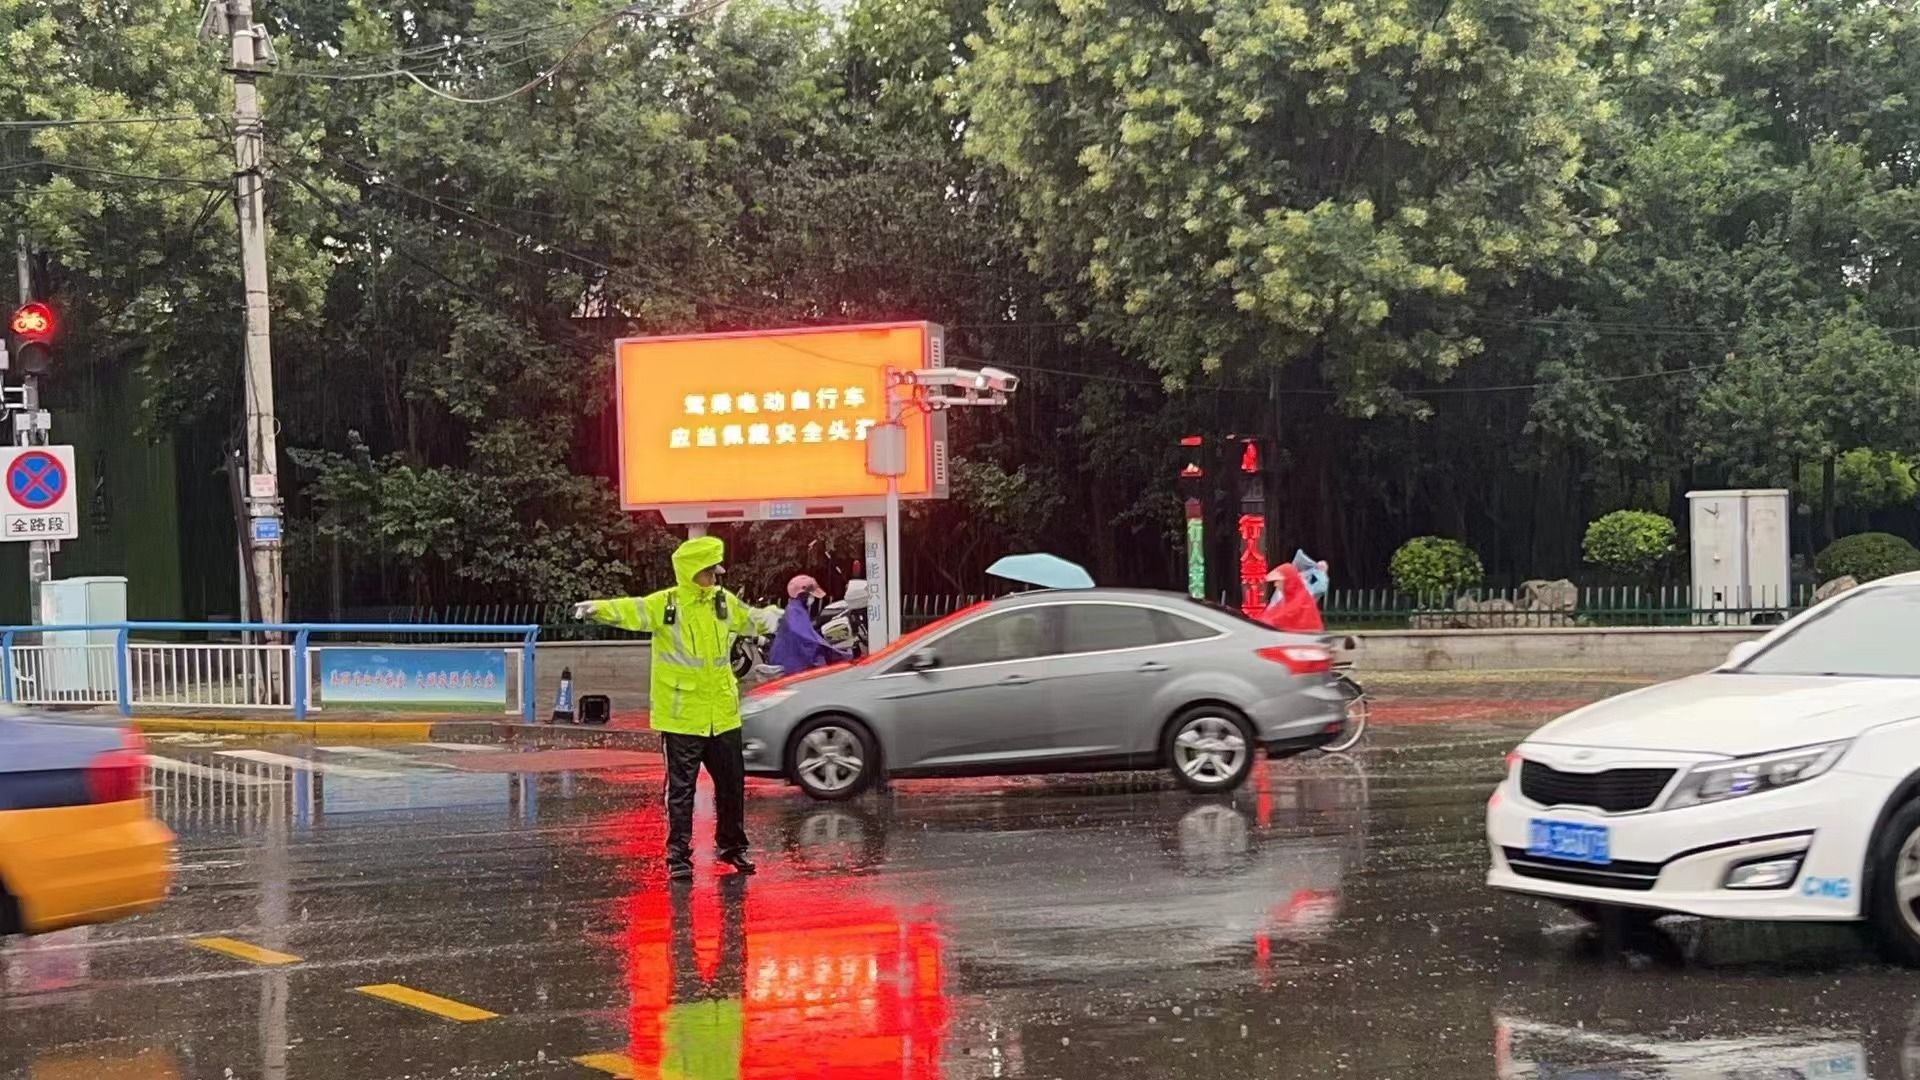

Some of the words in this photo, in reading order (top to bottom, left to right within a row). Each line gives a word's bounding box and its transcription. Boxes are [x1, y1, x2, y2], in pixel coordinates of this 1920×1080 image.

[684, 387, 865, 415] 驾乘电动自行车
[11, 517, 65, 533] 全路段
[1239, 515, 1267, 616] 行人禁止
